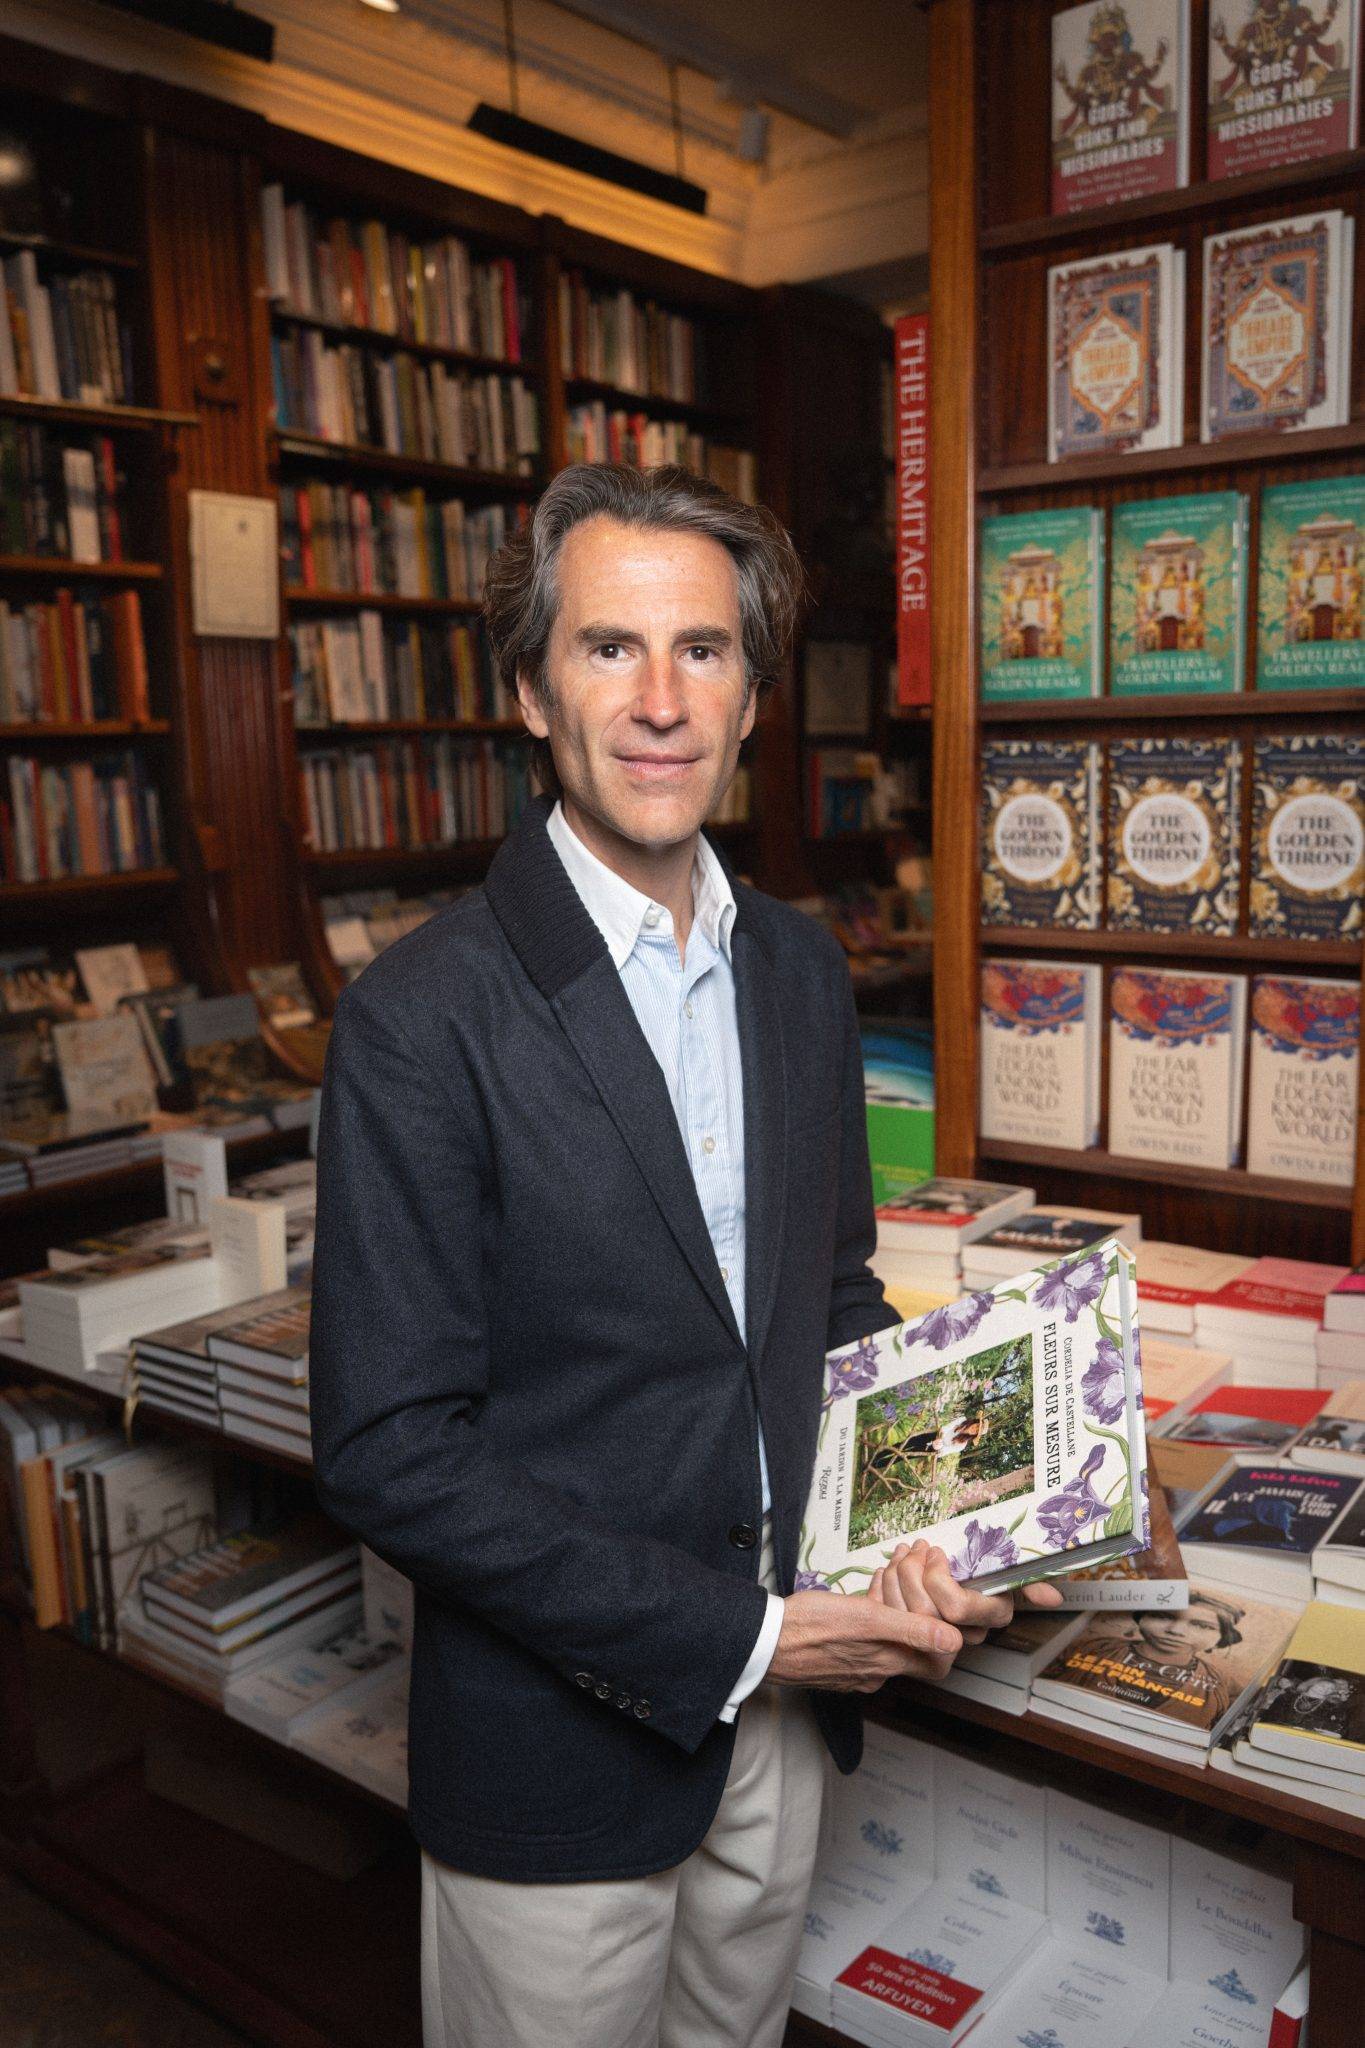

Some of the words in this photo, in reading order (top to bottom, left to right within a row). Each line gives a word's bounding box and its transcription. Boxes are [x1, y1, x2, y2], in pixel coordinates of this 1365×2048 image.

[1281, 77, 1316, 101] AND
[1218, 97, 1334, 143] MISSIONARIES
[1061, 137, 1164, 177] MISSIONARIES
[900, 328, 927, 401] THE
[900, 409, 928, 613] HERMITAGE
[1017, 814, 1046, 827] THE
[1151, 815, 1182, 828] THE
[1298, 816, 1333, 830] THE
[1001, 831, 1062, 842] GOLDEN
[1130, 832, 1201, 845] GOLDEN
[1275, 833, 1355, 847] GOLDEN
[1001, 846, 1062, 858] THRONE
[1131, 848, 1200, 862] THRONE
[1275, 850, 1355, 865] THRONE
[1025, 1043, 1055, 1059] FAR
[1135, 1055, 1160, 1069] THE
[1164, 1055, 1198, 1073] FAR
[1132, 1069, 1185, 1087] EDGES
[1278, 1068, 1305, 1084] THE
[1311, 1069, 1348, 1089] FAR
[1000, 1087, 1060, 1112] WORLD
[1128, 1086, 1203, 1109] KNOWN
[1274, 1083, 1333, 1103] EDGES
[1132, 1102, 1202, 1129] WORLD
[1270, 1099, 1354, 1125] KNOWN
[1273, 1117, 1350, 1146] WORLD
[1043, 1321, 1058, 1382] FLEURS
[1063, 1336, 1074, 1382] CORDELIA
[1065, 1382, 1075, 1396] DE
[1045, 1384, 1060, 1419] SUR
[1066, 1397, 1077, 1459] CASTELLANE
[1046, 1420, 1062, 1489] MESURE
[833, 1498, 843, 1532] MAISON
[1203, 1499, 1228, 1516] IL
[1063, 1590, 1094, 1603] erin
[1099, 1589, 1146, 1603] Lauder
[1065, 1659, 1107, 1675] DES
[1072, 1651, 1097, 1665] LE
[1098, 1658, 1147, 1680] PAIN
[1122, 1652, 1152, 1672] Le
[1096, 1680, 1151, 1703] Gallimard
[1195, 1898, 1211, 1914] Le
[1215, 1905, 1273, 1940] Bouddha
[864, 1960, 881, 1974] 50
[881, 1969, 903, 1984] ans
[860, 1978, 937, 2017] ARFUYEN
